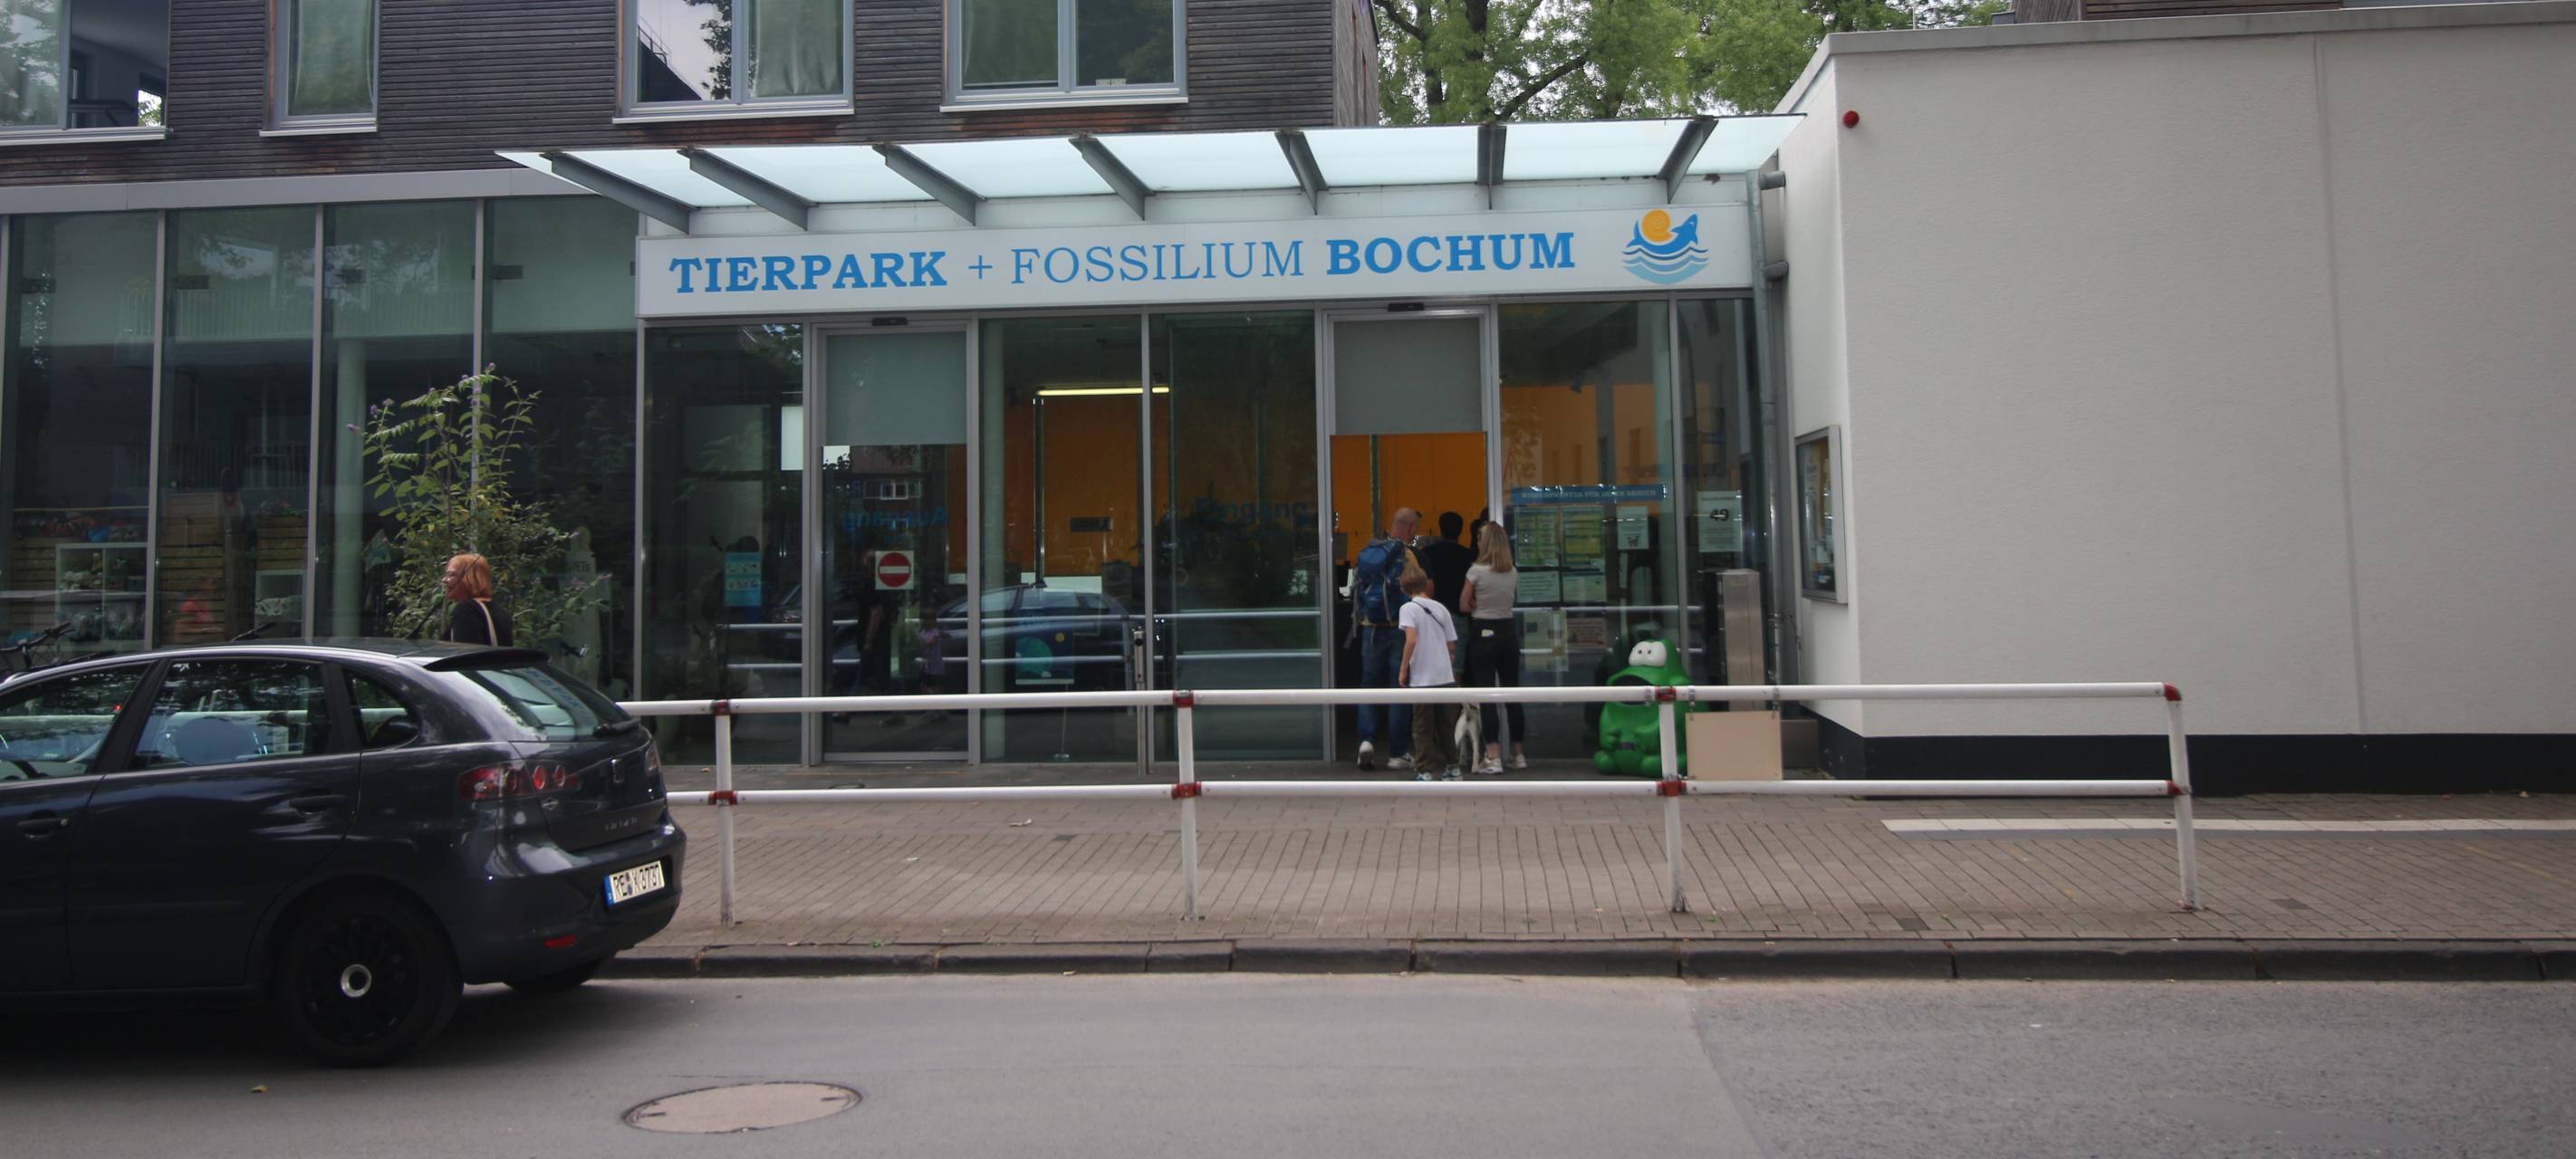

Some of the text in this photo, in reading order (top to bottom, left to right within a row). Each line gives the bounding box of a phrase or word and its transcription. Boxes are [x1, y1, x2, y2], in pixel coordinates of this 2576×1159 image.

[668, 232, 1576, 295] TIERPARK + FOSSILIUM BOCHUM
